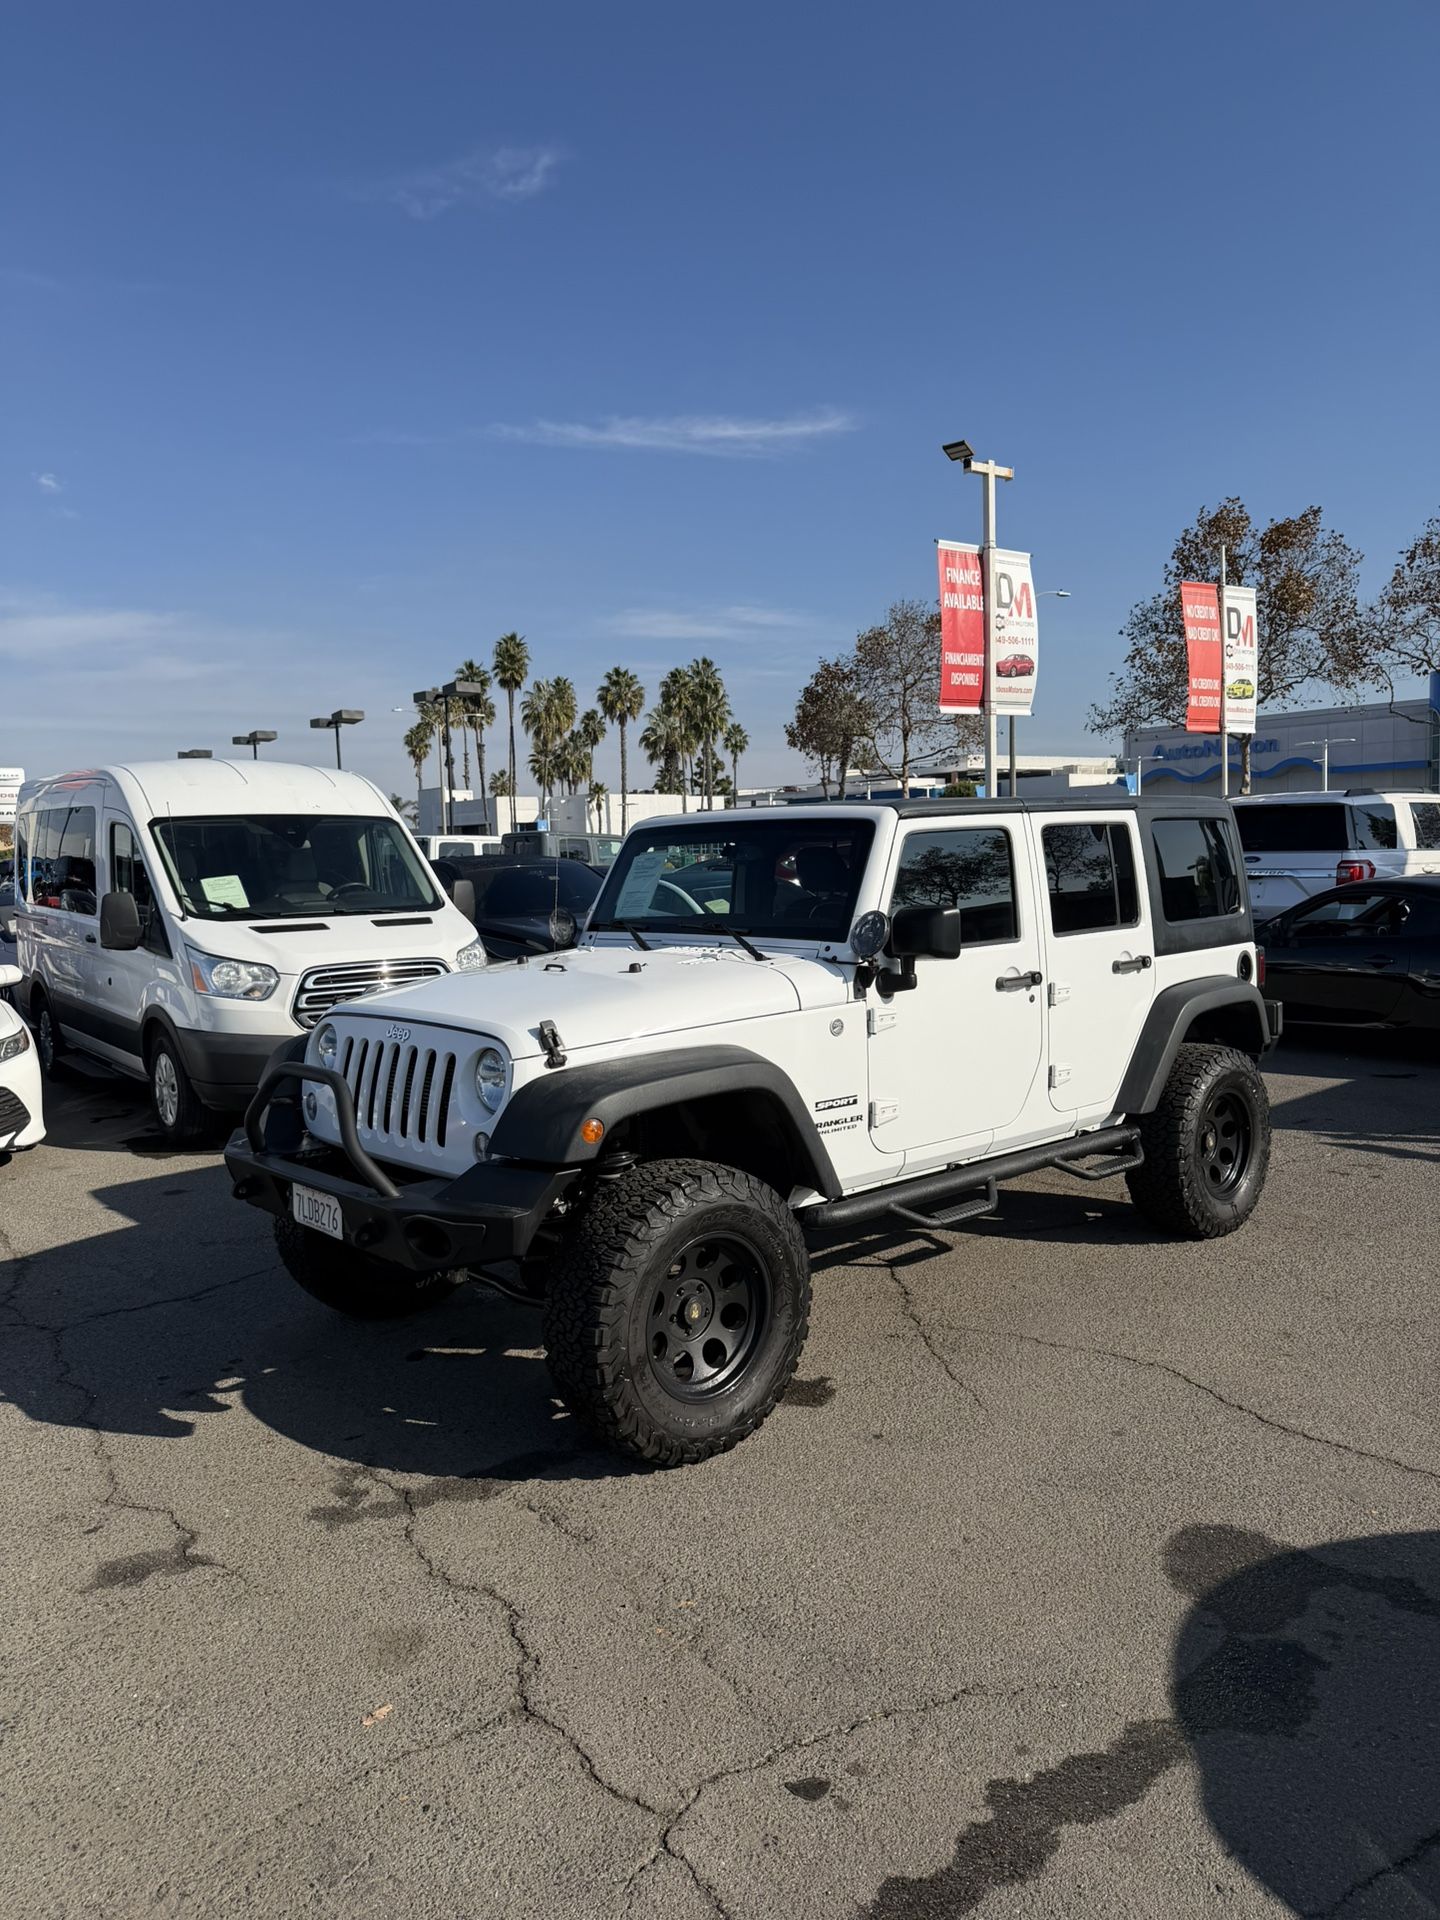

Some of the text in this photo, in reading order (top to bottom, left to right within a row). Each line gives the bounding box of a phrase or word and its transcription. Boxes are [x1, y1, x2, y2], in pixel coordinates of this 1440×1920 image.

[946, 567, 981, 586] FINANCE
[951, 671, 979, 686] DISPONIBLE
[386, 1024, 411, 1043] Jeep
[816, 1097, 857, 1109] SPORT
[815, 1114, 863, 1129] RANGLER
[295, 1192, 339, 1231] 7LDB276
